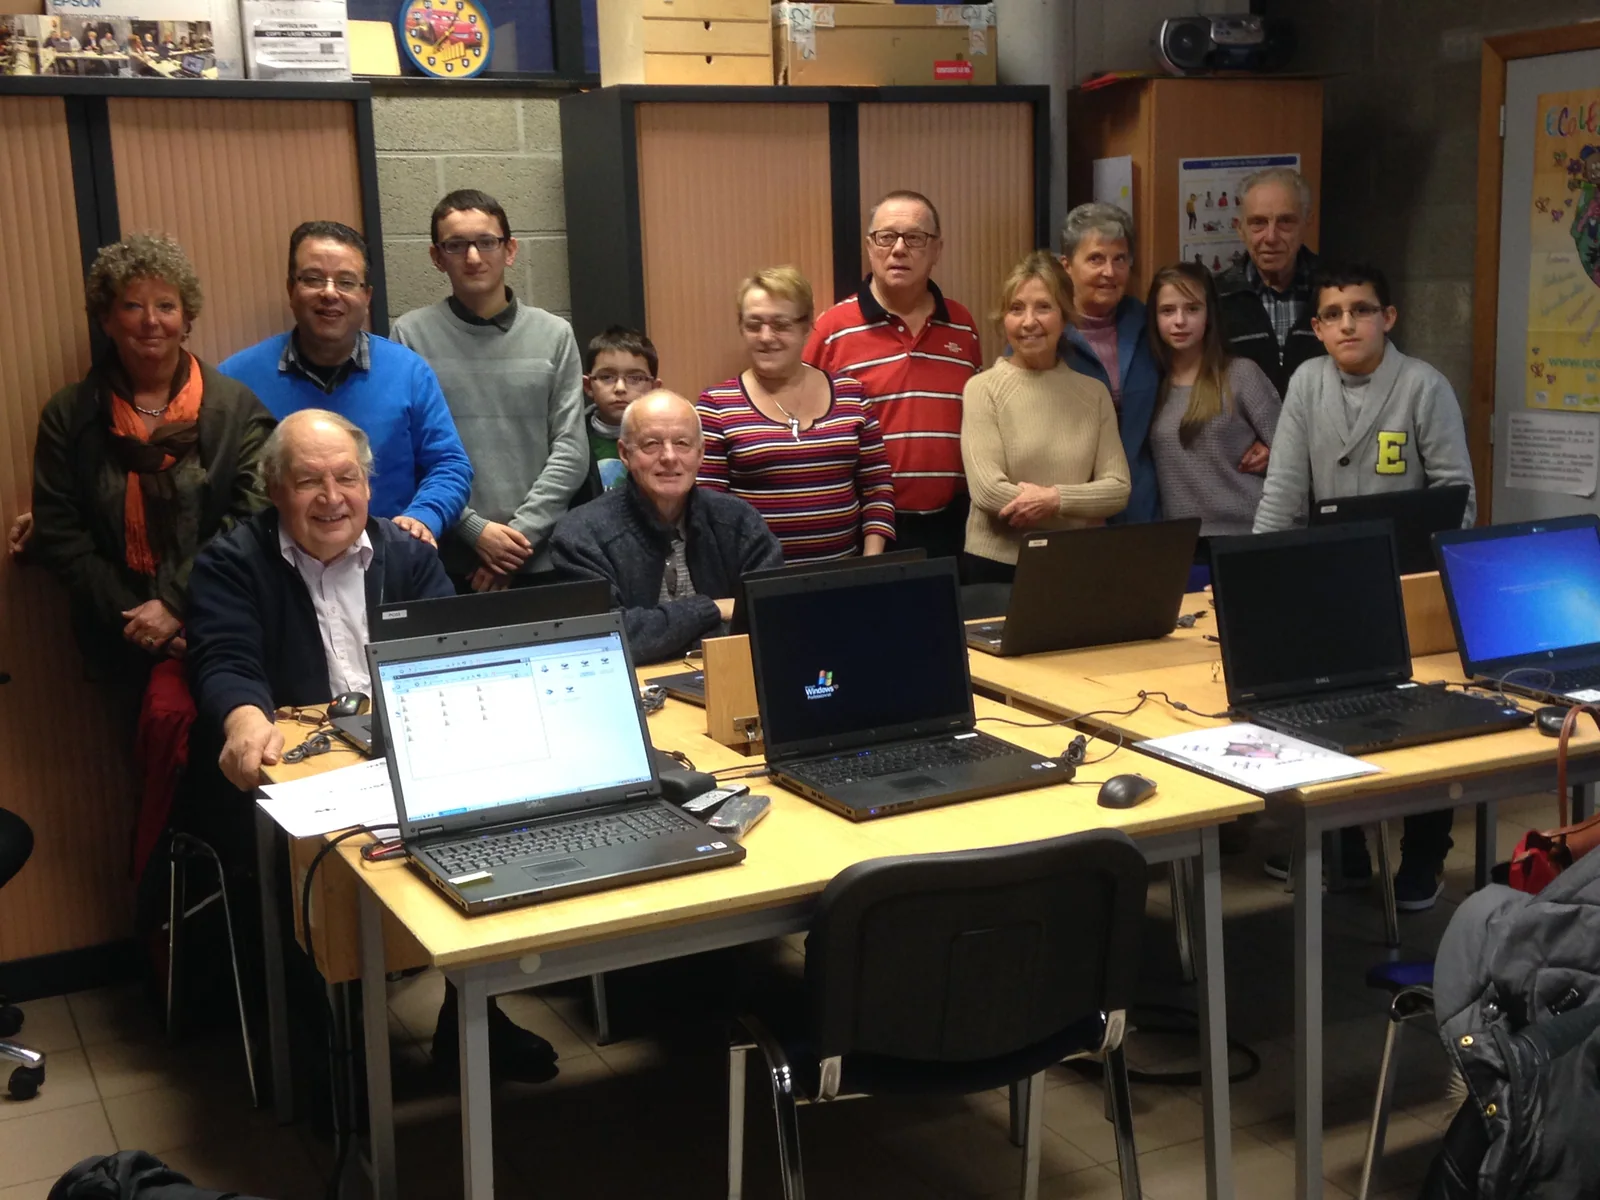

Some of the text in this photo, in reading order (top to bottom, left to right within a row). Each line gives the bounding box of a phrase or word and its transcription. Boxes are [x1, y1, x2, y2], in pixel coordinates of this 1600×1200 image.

[1376, 430, 1408, 475] E
[1315, 676, 1330, 685] DELL
[805, 686, 834, 696] Windows
